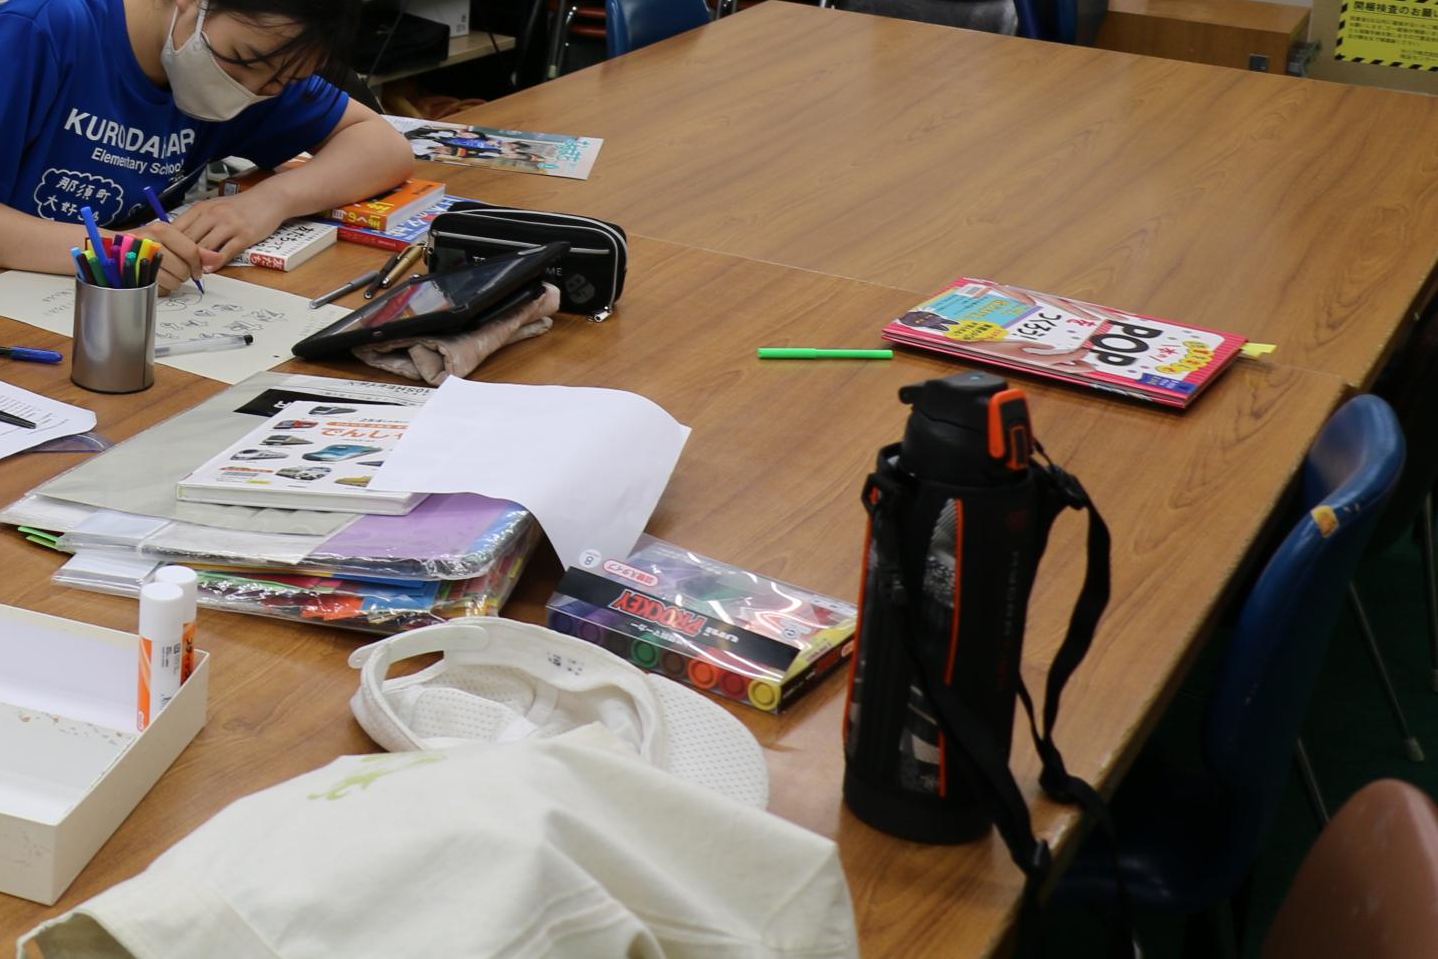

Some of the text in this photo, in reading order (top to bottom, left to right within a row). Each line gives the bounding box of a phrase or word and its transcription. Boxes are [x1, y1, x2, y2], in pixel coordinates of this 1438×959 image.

[1088, 319, 1164, 367] POP
[609, 589, 708, 637] PROCKEY
[702, 626, 740, 643] uni
